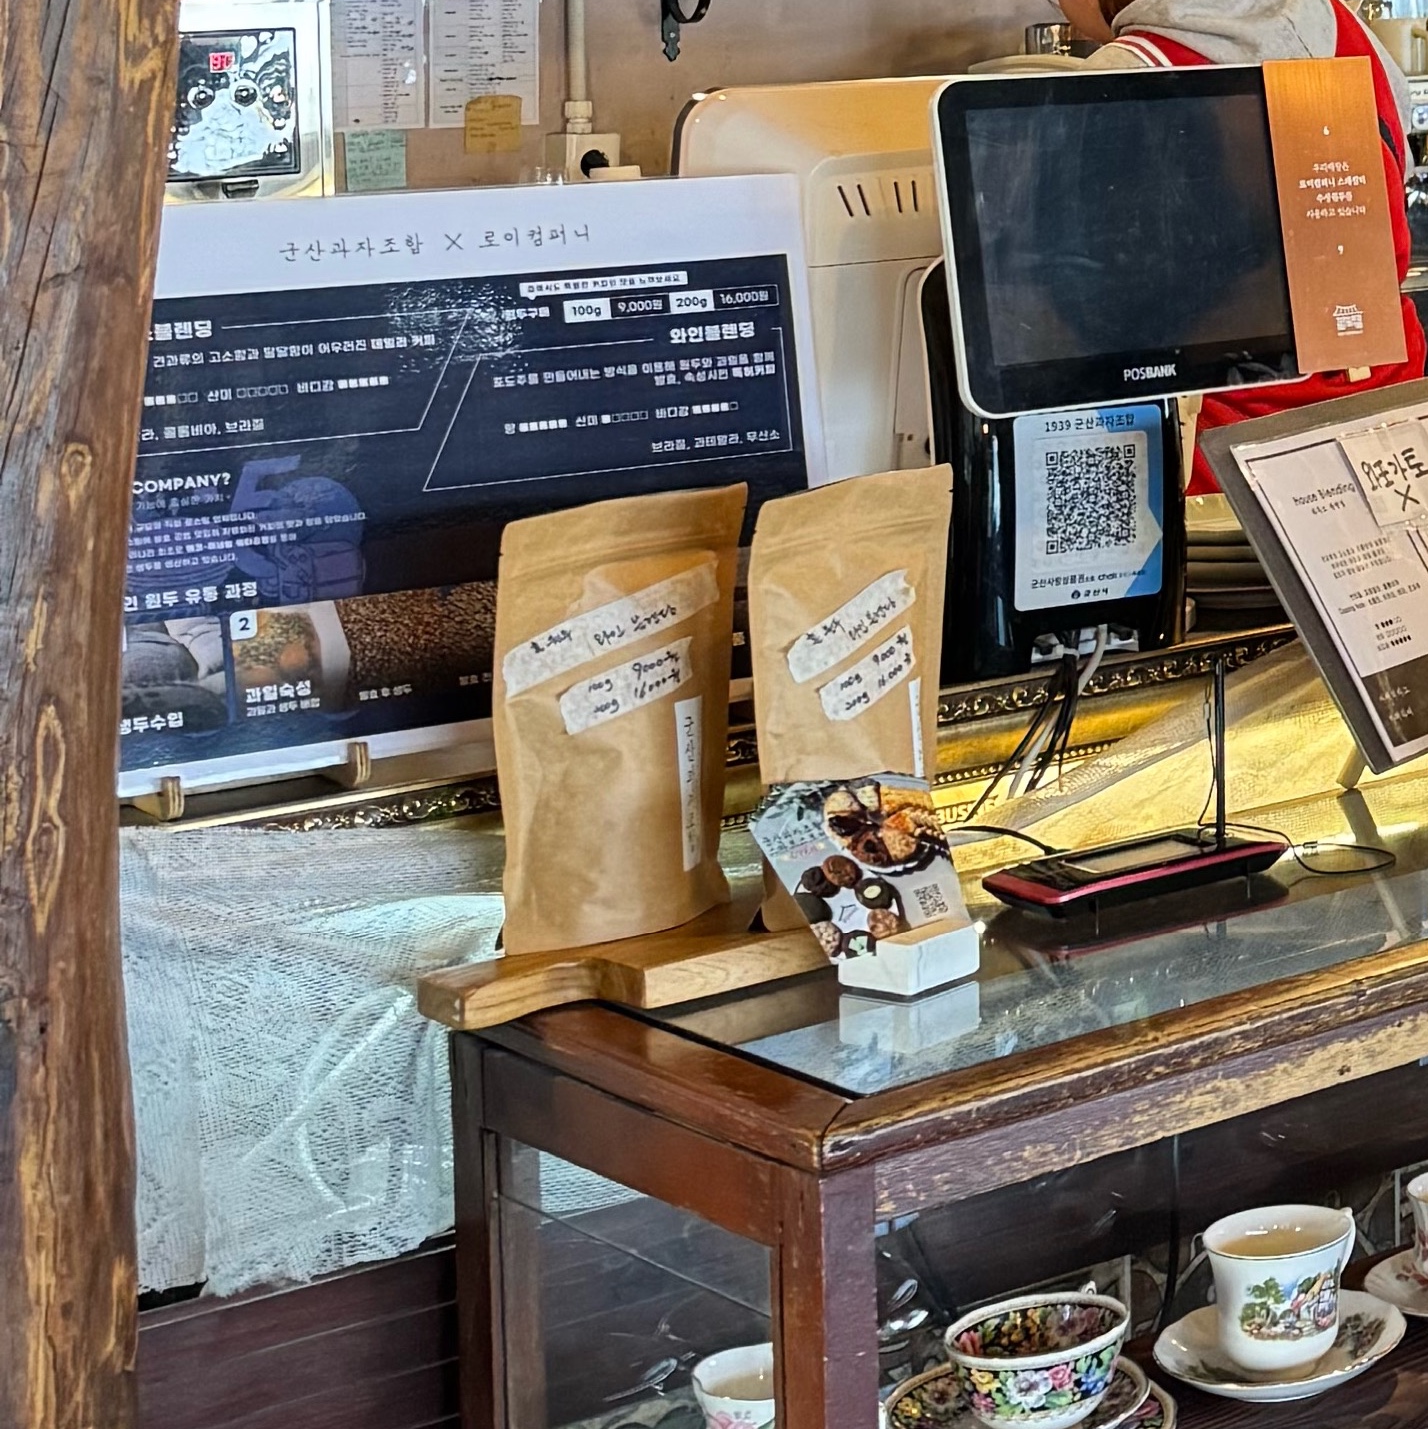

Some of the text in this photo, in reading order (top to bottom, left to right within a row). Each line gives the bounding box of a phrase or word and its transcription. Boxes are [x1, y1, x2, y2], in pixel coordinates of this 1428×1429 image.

[280, 233, 424, 262] 군산과자조합
[479, 224, 590, 248] 로이컴퍼니
[571, 305, 602, 318] 100g
[617, 299, 663, 313] 9,000원
[676, 294, 709, 309] 200g
[719, 290, 769, 304] 16,000원
[148, 320, 213, 342] 블렌딩
[670, 322, 755, 344] 와인블렌딩
[153, 351, 204, 368] 견과류의
[208, 347, 259, 363] 고소함과
[318, 339, 367, 355] 어우러진
[493, 373, 539, 388] 포도주를
[543, 368, 601, 384] 만들어내는
[604, 364, 638, 378] 방식을
[642, 360, 675, 374] 이용해
[680, 357, 713, 370] 원두와
[717, 353, 749, 367] 과일을
[684, 368, 728, 382] 숙성시킨
[1123, 363, 1177, 381] POSBANK
[207, 379, 334, 403] 산미 바디감
[225, 418, 265, 433] 브라질
[576, 414, 599, 428] 산미
[655, 405, 690, 419] 바디감
[1045, 413, 1135, 433] 1939 군산과자조합
[132, 472, 231, 495] COMPANY?
[145, 591, 179, 610] 원두
[185, 584, 218, 604] 유통
[225, 581, 258, 600] 과정
[238, 617, 251, 632] 2
[246, 680, 312, 704] 과일숙성
